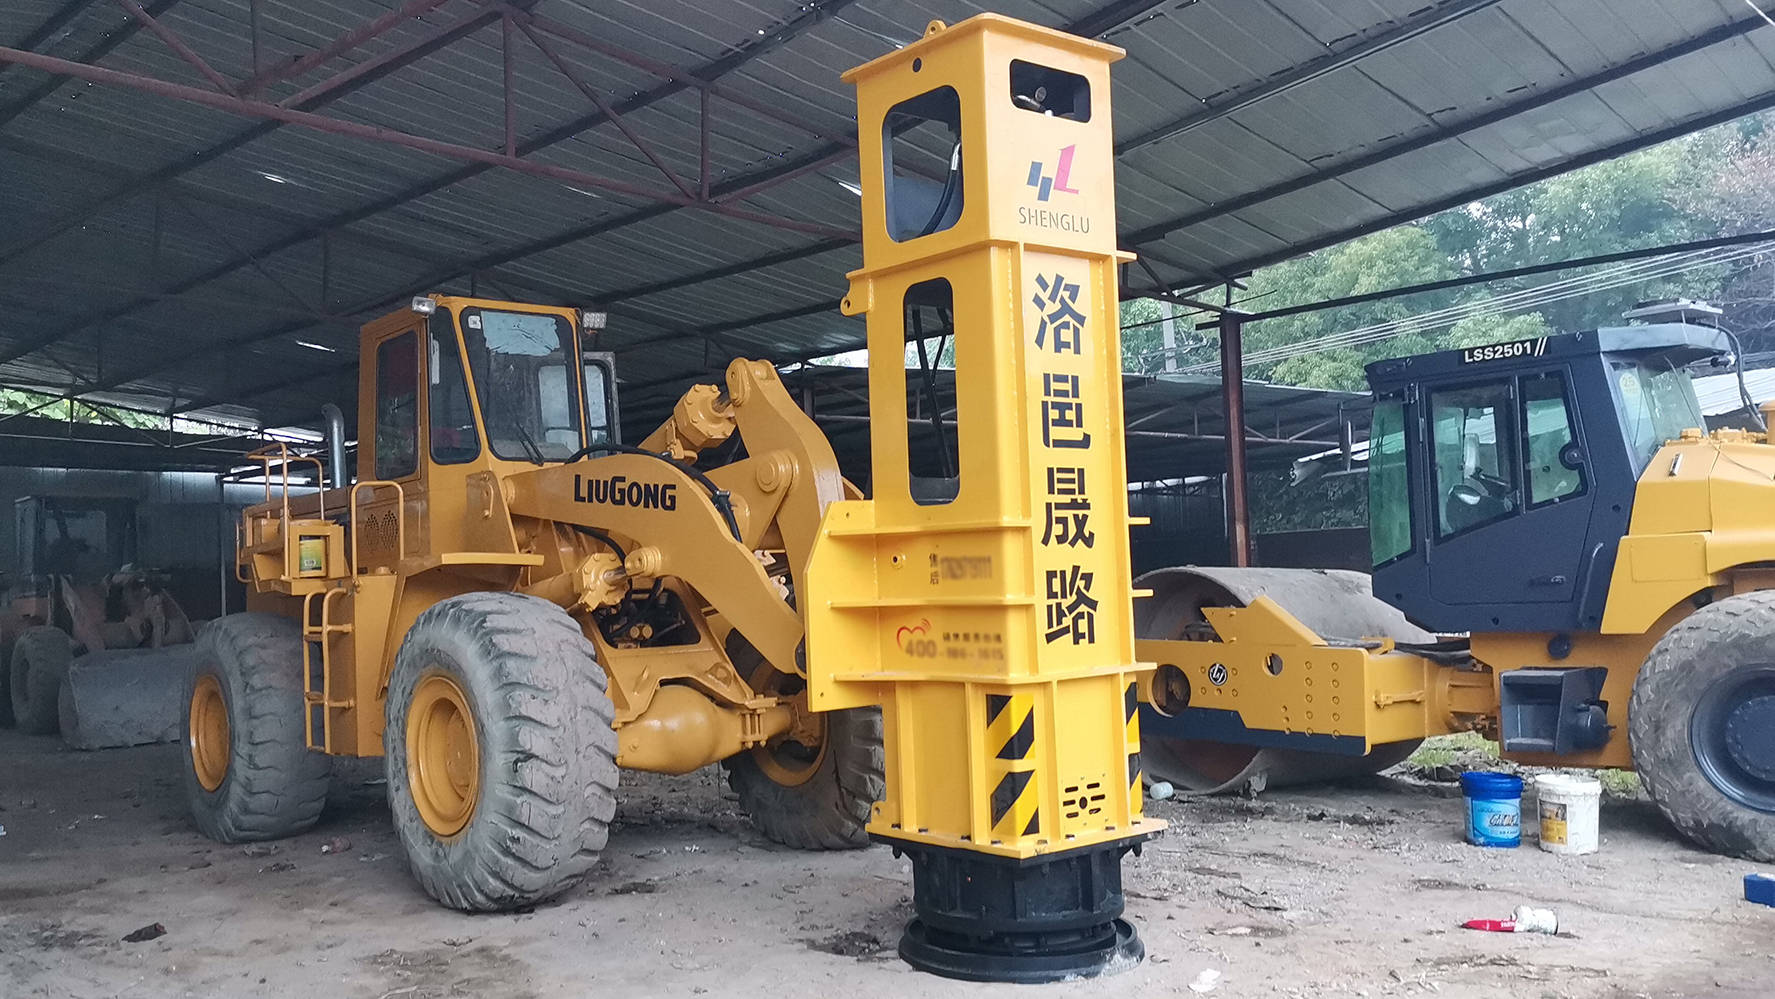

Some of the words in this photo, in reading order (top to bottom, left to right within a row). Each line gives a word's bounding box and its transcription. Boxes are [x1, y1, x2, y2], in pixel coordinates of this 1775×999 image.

[1019, 206, 1090, 234] SHENGLU
[1031, 272, 1099, 646] 洛邑晟路
